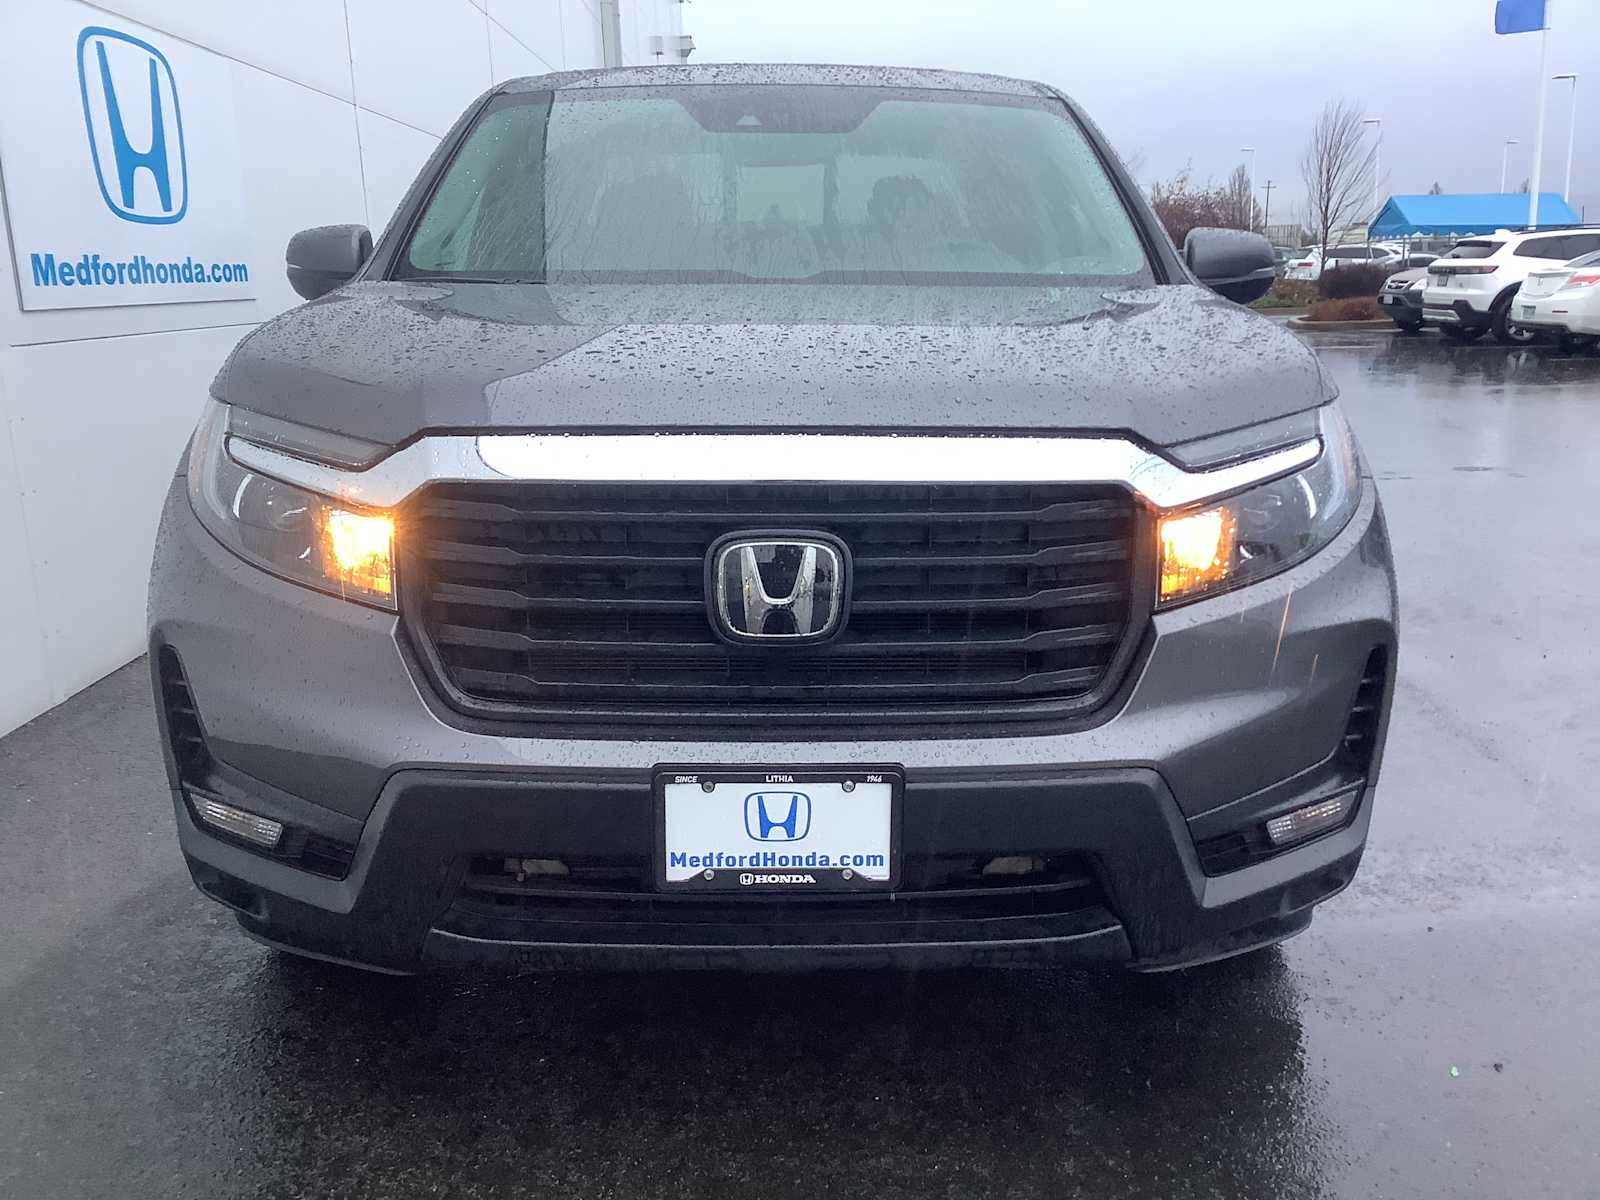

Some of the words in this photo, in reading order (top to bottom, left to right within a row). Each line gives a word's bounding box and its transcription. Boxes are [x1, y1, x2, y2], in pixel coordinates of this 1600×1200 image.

[30, 252, 249, 287] Medfordhonda.com
[674, 775, 698, 783] SINCE
[765, 775, 794, 783] LITHIA
[866, 775, 882, 783] 1946
[670, 851, 884, 868] MedfordHonda.com
[754, 874, 816, 884] HONDA
